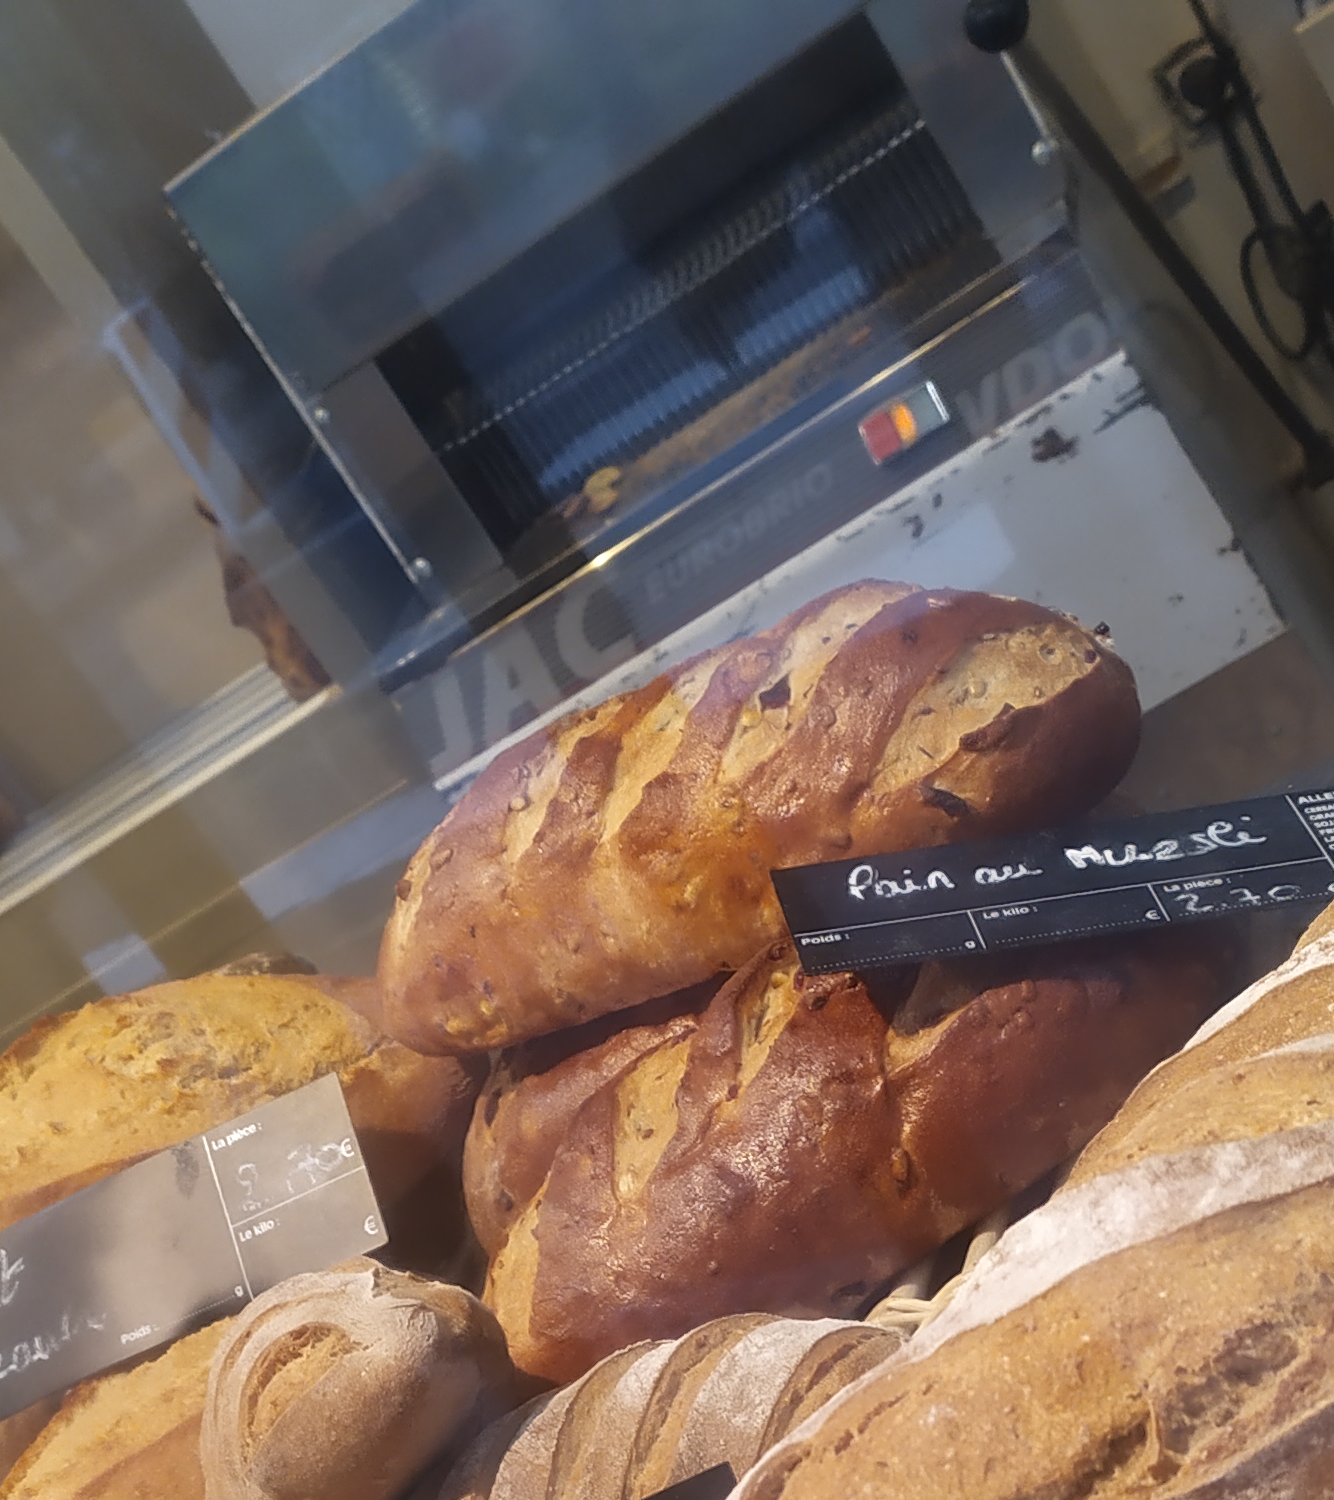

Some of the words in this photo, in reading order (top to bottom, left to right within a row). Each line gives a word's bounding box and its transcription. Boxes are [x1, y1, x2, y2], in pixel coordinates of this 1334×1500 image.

[429, 576, 637, 776] JAC
[847, 864, 956, 900] Pain
[974, 864, 1043, 886] au
[1163, 882, 1181, 893] La
[1184, 876, 1224, 890] pièce
[983, 910, 999, 920] Le
[1003, 904, 1030, 916] kilo
[800, 932, 842, 947] Poids
[211, 1138, 225, 1150] La
[227, 1123, 257, 1146] pièce
[238, 1228, 253, 1242] Le
[254, 1219, 275, 1236] kilo
[120, 1324, 151, 1345] Poids
